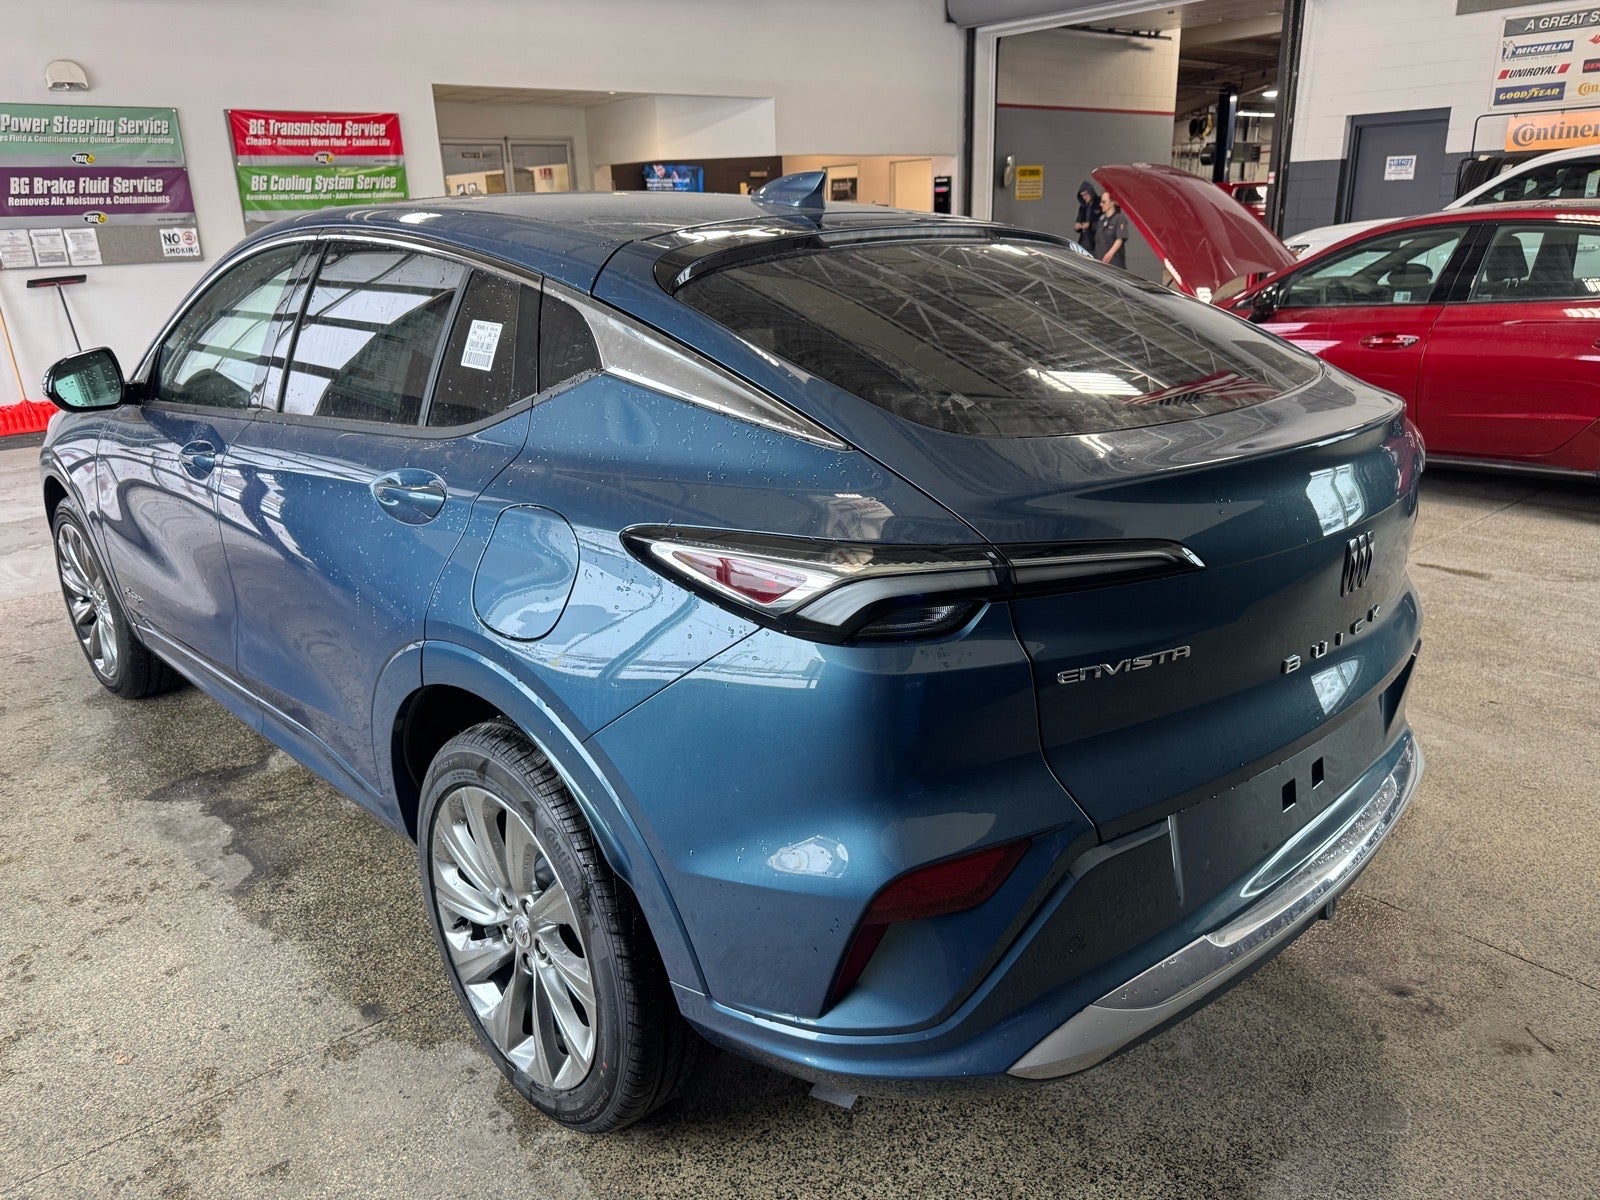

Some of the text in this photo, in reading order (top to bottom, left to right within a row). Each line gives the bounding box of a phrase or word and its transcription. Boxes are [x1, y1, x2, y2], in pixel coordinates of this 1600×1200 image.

[1525, 11, 1600, 31] A GREAT S
[1516, 42, 1572, 55] MICHELIN
[1508, 65, 1557, 78] UNIROYAL
[1499, 86, 1560, 100] GOODYEAR
[1577, 82, 1600, 96] Con
[1, 114, 169, 136] Power Steering Service
[249, 119, 386, 137] BG Transmission Service
[9, 134, 27, 142] Fluid
[34, 135, 78, 143] Conditioners
[147, 136, 175, 145] Steering
[245, 137, 391, 147] Cleans Removes Worn Fluid Extends Life
[10, 176, 164, 195] BG Brake Fluid Service
[251, 174, 397, 193] BG Cooling System Service
[8, 195, 170, 206] Removes Air, Moisture & Contaminants
[163, 233, 181, 244] NO
[1282, 603, 1381, 675] BUICK
[1056, 645, 1192, 685] ENVISTA
